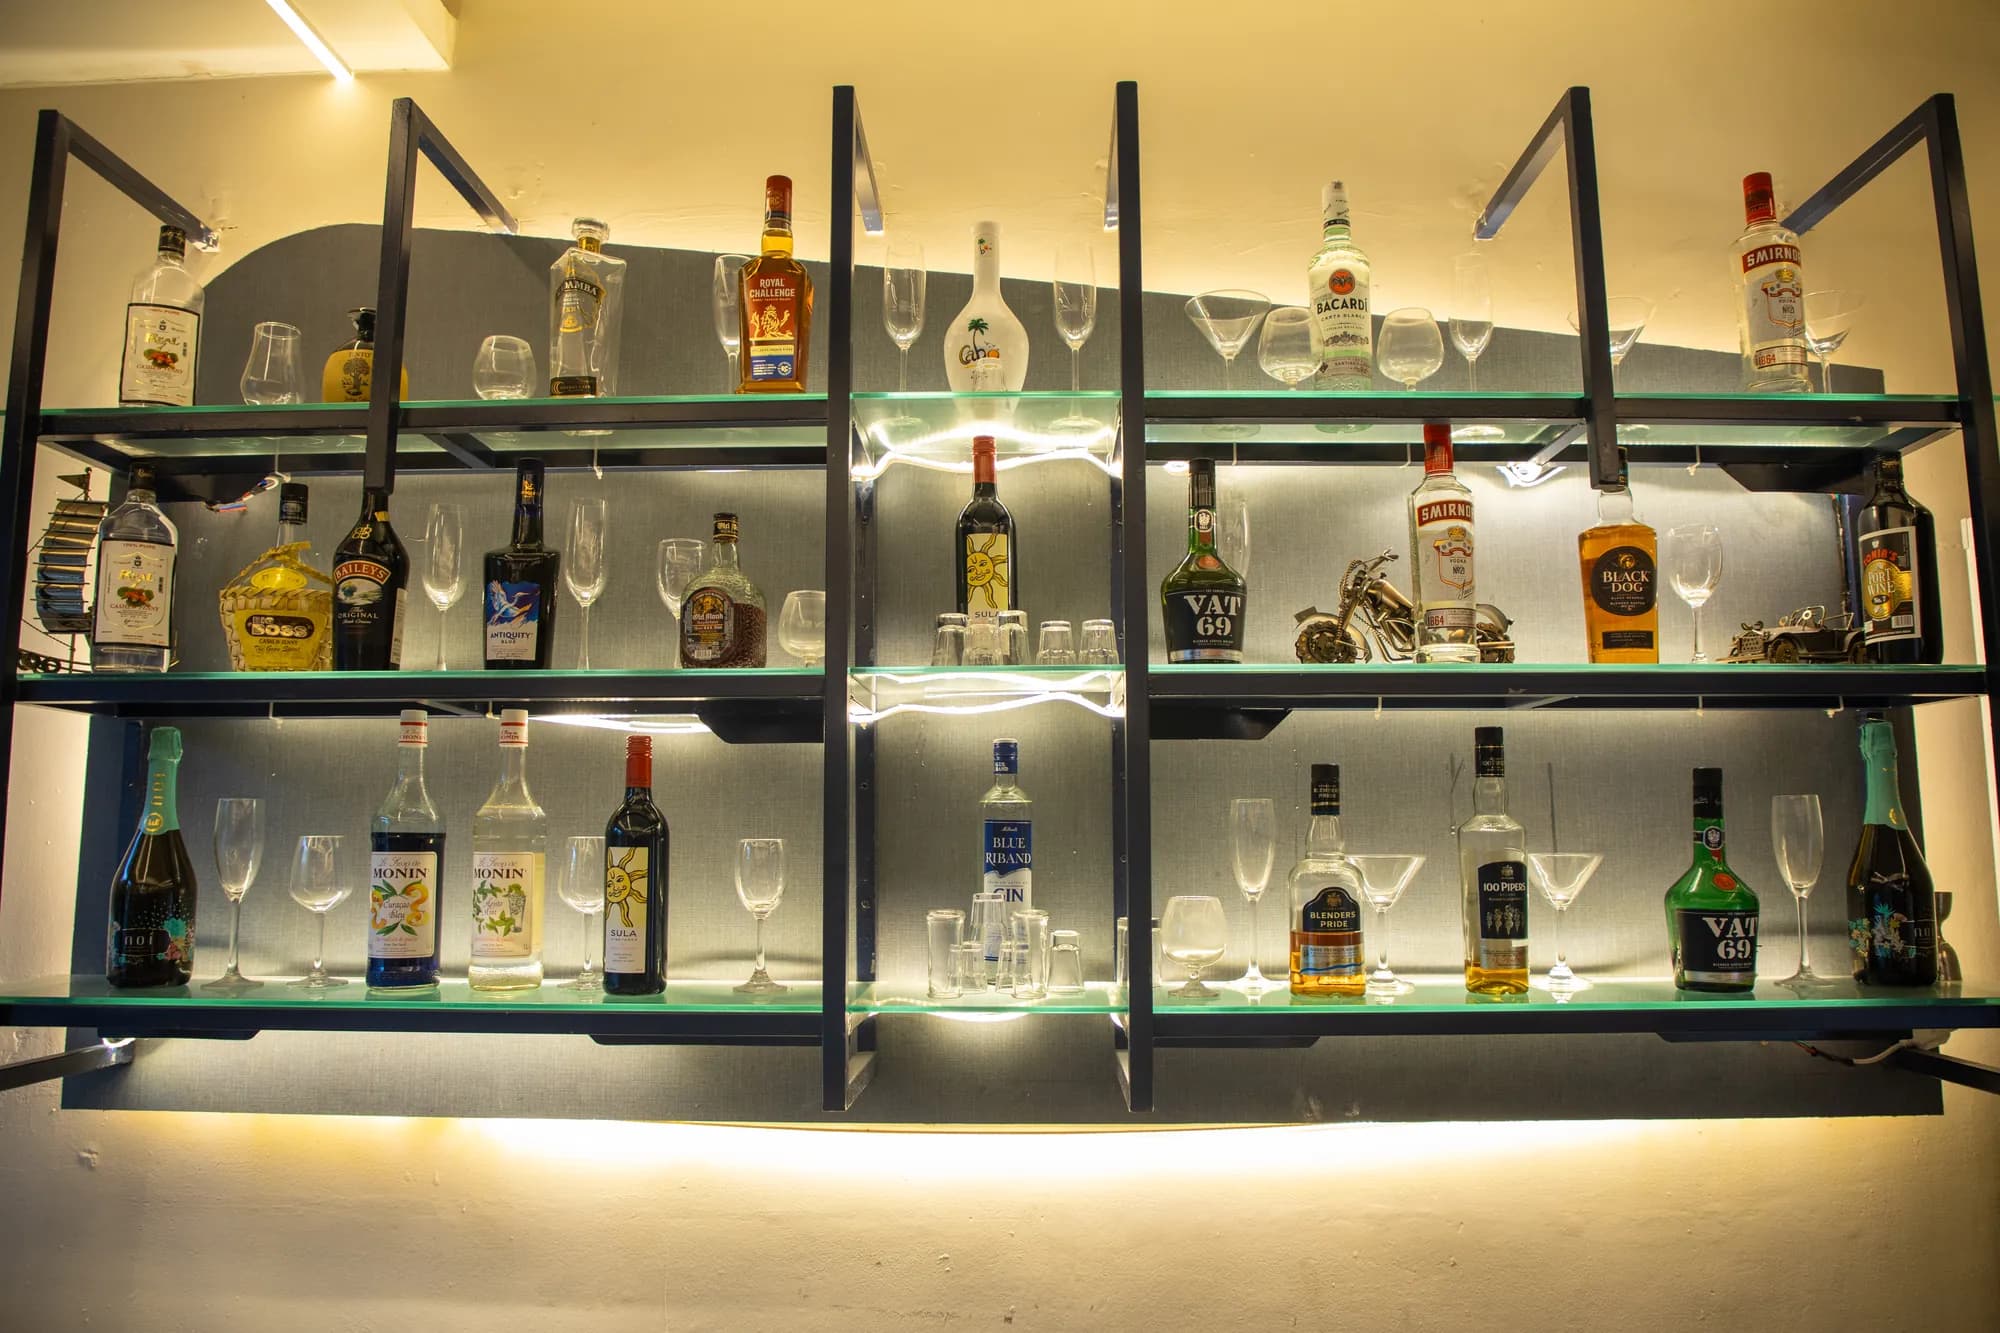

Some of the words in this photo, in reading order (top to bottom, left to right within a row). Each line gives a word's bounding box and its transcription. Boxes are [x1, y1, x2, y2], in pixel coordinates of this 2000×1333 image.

[760, 278, 785, 288] ROYAL
[750, 288, 796, 298] CHALLENGE
[336, 563, 386, 579] BAILEYS
[1603, 570, 1649, 583] BLACK
[1868, 569, 1890, 585] PORT
[1611, 582, 1643, 592] DOG
[1868, 581, 1895, 599] WINE
[1184, 595, 1241, 616] VAT
[251, 623, 307, 638] BOSS
[1197, 616, 1231, 636] 69
[993, 837, 1026, 849] BLUE
[985, 852, 1031, 866] RIBAND
[373, 868, 427, 878] MONIN
[474, 868, 524, 879] MONIN
[1483, 882, 1500, 892] 100
[1501, 882, 1526, 892] PIPERS
[1310, 911, 1356, 919] BLENDERS
[1320, 920, 1348, 928] PRIDE
[1702, 917, 1758, 938] VAT
[610, 929, 637, 937] SULA
[1717, 939, 1751, 959] 69
